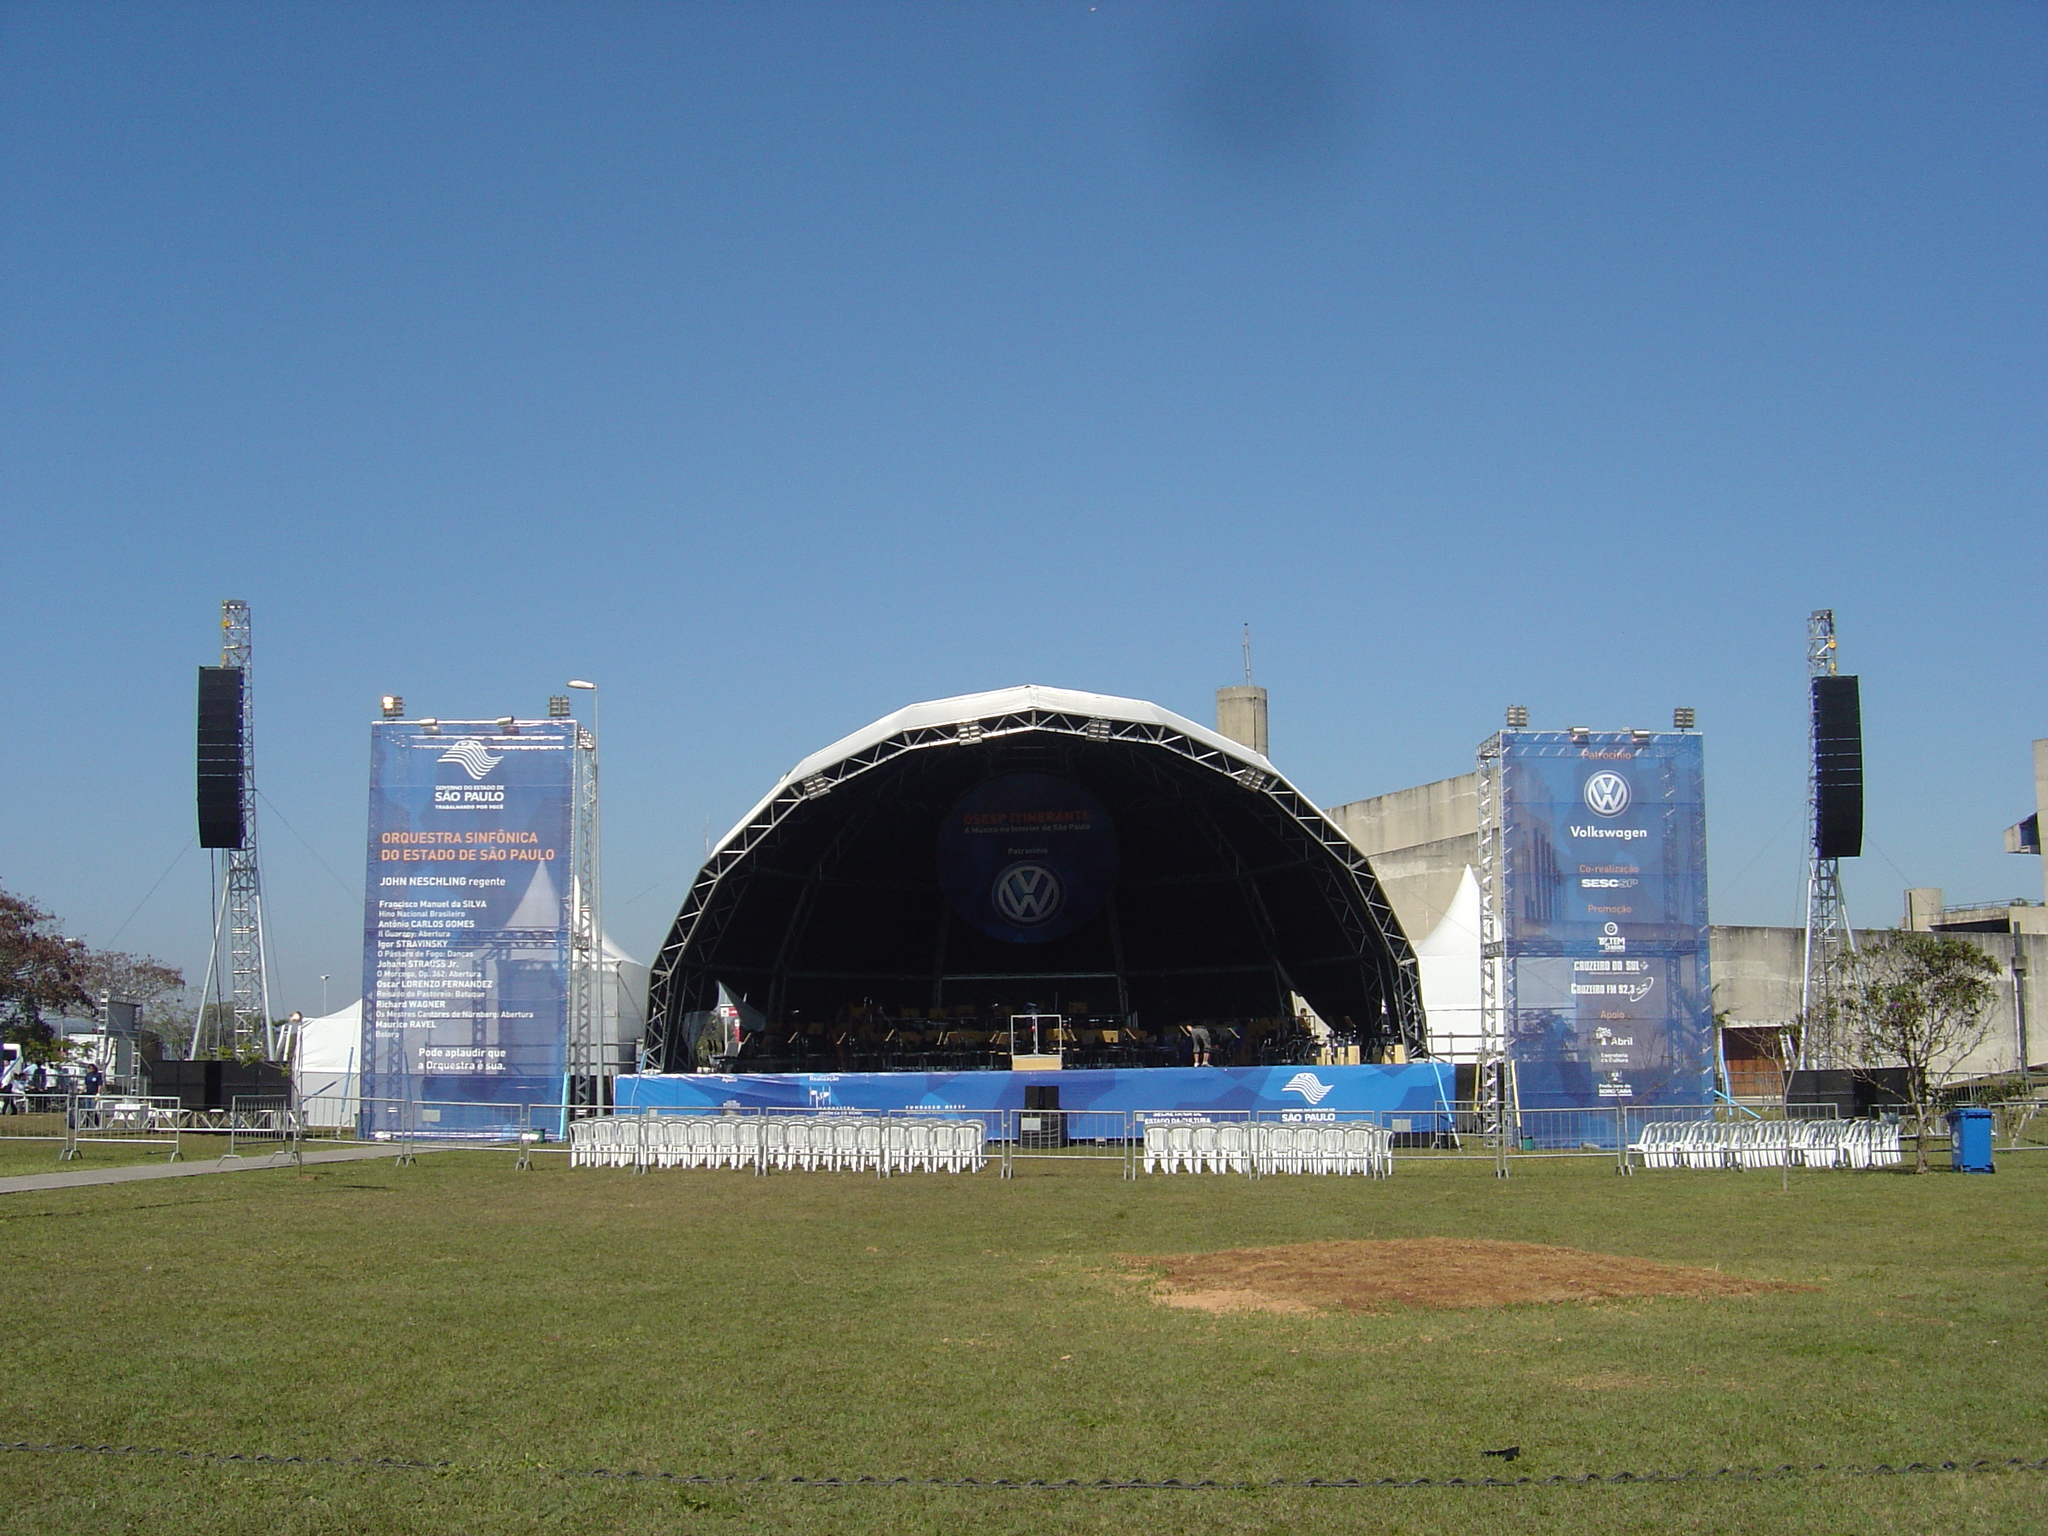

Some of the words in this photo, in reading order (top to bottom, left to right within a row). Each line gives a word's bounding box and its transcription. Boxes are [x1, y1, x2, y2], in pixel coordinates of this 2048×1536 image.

[1581, 748, 1632, 760] Patrocínio
[464, 791, 505, 802] PAULO
[1010, 811, 1090, 824] ITINERANTE
[964, 826, 971, 834] A
[1069, 822, 1092, 830] Paulo
[1570, 825, 1647, 840] Volkswagen
[382, 832, 462, 845] ORQUESTRA
[465, 829, 538, 844] SINFÔNICA
[381, 850, 399, 861] DO
[403, 850, 455, 861] ESTADO
[459, 849, 477, 861] DE
[480, 846, 506, 861] SÃO
[510, 849, 555, 860] PAULO
[1579, 864, 1639, 875] Co-realização
[380, 877, 407, 886] JOHN
[409, 877, 466, 886] NESCHLING
[468, 877, 506, 888] regente
[379, 900, 418, 908] Francisco
[420, 900, 449, 908] Manuel
[451, 900, 461, 908] da
[462, 900, 487, 908] SILVA
[1588, 904, 1632, 914] Promoção
[378, 919, 409, 928] Antônio
[411, 920, 444, 928] CARLOS
[445, 920, 475, 928] GOMES
[378, 940, 395, 949] Igor
[396, 940, 448, 948] STRAVINSKY
[447, 950, 474, 959] Danças
[377, 960, 407, 968] Johann
[408, 960, 446, 968] STRAUSS
[447, 960, 459, 968] Jr.
[1574, 960, 1610, 971] CRUZEIRO
[1612, 960, 1623, 971] DO
[1626, 960, 1640, 971] SUL
[376, 980, 400, 988] Oscar
[401, 980, 441, 988] LORENZO
[442, 980, 493, 988] FERNANDEZ
[1606, 984, 1617, 994] FM
[406, 990, 416, 998] do
[455, 990, 486, 999] Batuque
[376, 1000, 407, 1008] Richard
[408, 1000, 446, 1008] WAGNER
[417, 1010, 450, 1018] Cantores
[451, 1010, 461, 1018] de
[500, 1010, 534, 1018] Abertura
[1600, 1010, 1625, 1020] Apoio
[375, 1020, 408, 1028] Maurice
[409, 1020, 437, 1028] RAVEL
[1611, 1036, 1633, 1046] Abril
[418, 1048, 443, 1057] Pode
[445, 1048, 486, 1058] aplaudir
[487, 1049, 507, 1058] que
[417, 1062, 424, 1070] a
[426, 1061, 475, 1071] Orquestra
[477, 1060, 483, 1070] é
[485, 1062, 506, 1070] sua.
[1304, 1112, 1336, 1122] PAULO
